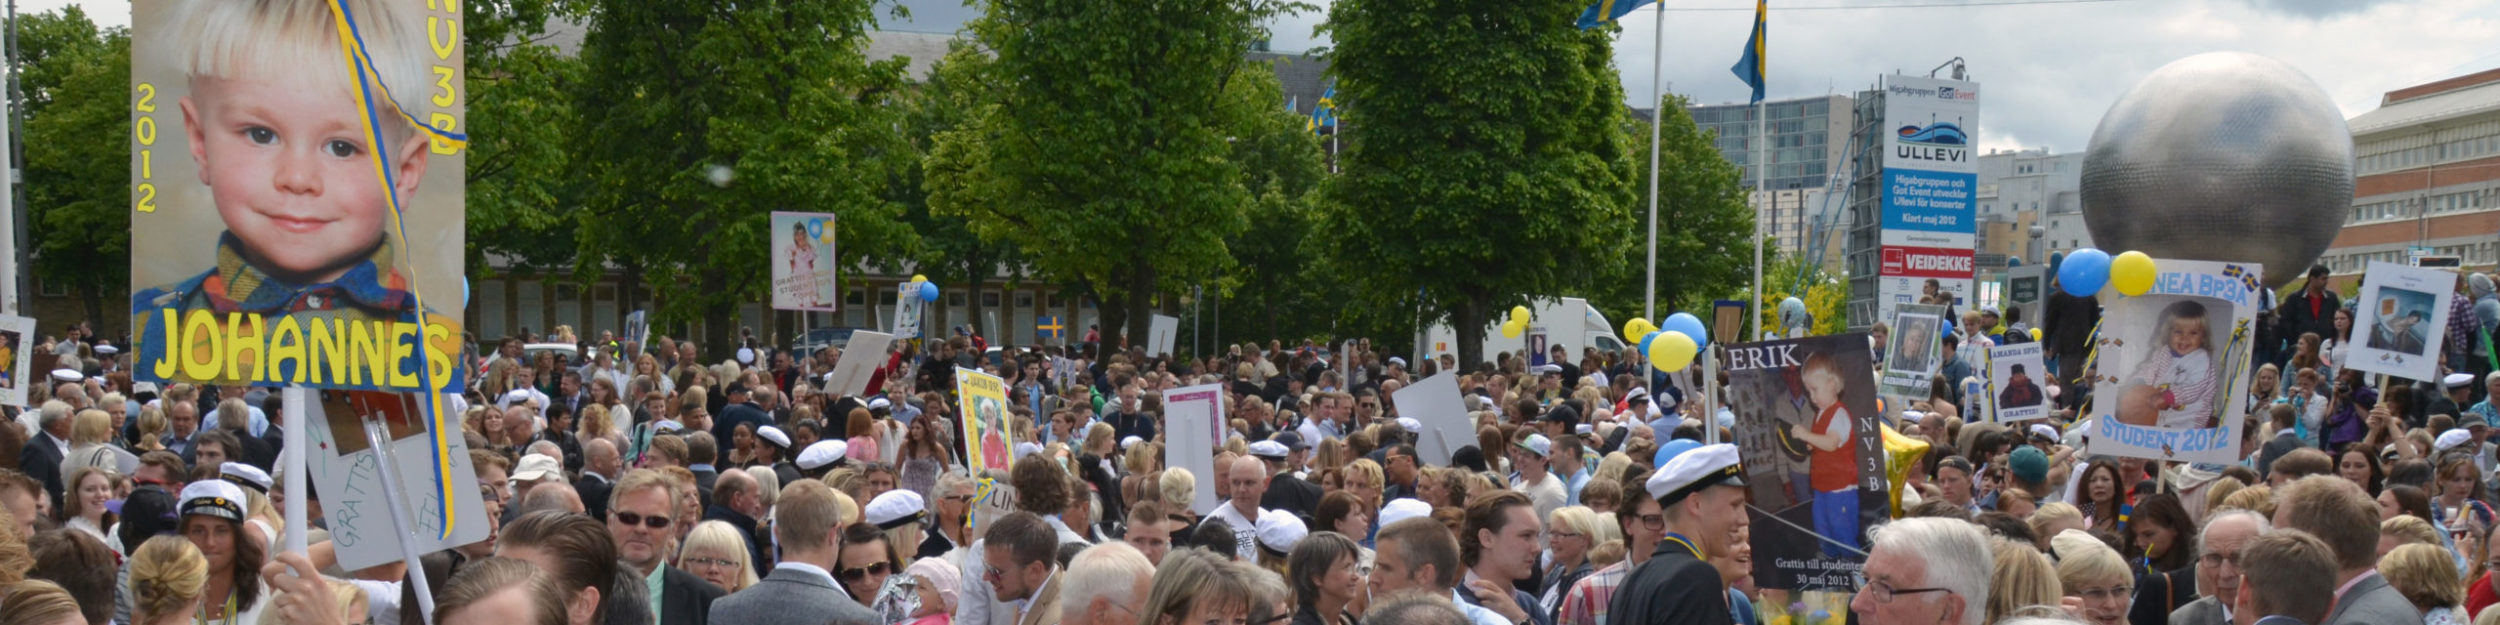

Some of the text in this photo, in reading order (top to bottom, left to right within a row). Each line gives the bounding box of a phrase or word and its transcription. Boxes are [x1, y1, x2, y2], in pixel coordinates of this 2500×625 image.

[136, 82, 156, 213] 2012
[1897, 145, 1967, 163] ULLEVI
[1895, 174, 1966, 188] Higabgruppen och
[1892, 185, 1968, 199] Got Event utvecklar
[1893, 195, 1966, 209] Ullevi för konserter
[1902, 213, 1957, 226] Klart maj 2012
[1905, 254, 1972, 272] VEIDEKKE
[154, 308, 453, 390] JOHANNES
[1728, 344, 1801, 371] ERIK
[2003, 408, 2039, 418] GRATTIS!
[2102, 414, 2179, 449] STUDENT
[1860, 417, 1880, 492] NV3B
[333, 452, 376, 548] GRATTIS
[1775, 557, 1805, 570] Grattis
[1806, 558, 1820, 570] till
[1796, 574, 1850, 588] 30 maj 2012
